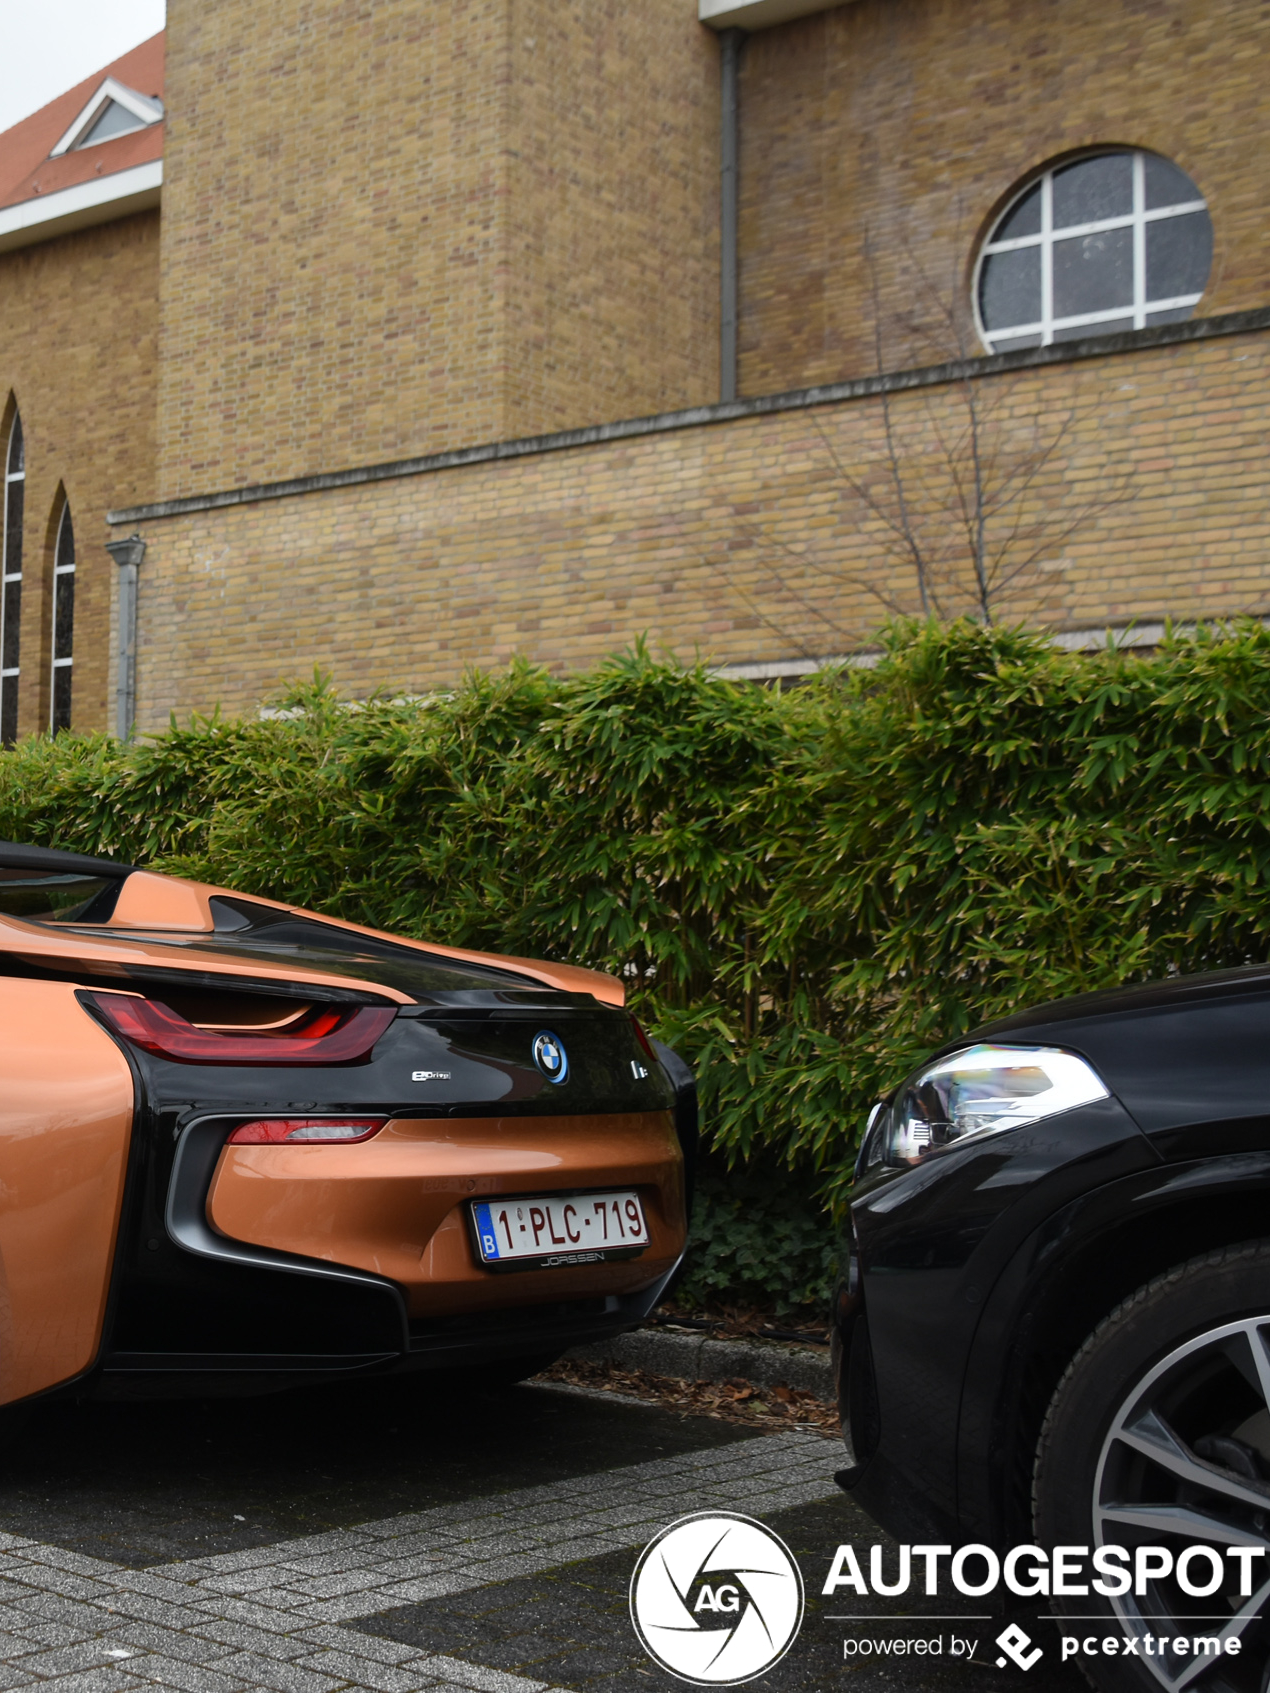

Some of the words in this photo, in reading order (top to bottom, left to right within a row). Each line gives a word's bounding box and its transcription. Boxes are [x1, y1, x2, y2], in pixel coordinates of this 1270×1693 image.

[499, 1199, 642, 1249] 1-PLC-719
[483, 1235, 496, 1254] B
[540, 1252, 605, 1267] JORSSEN
